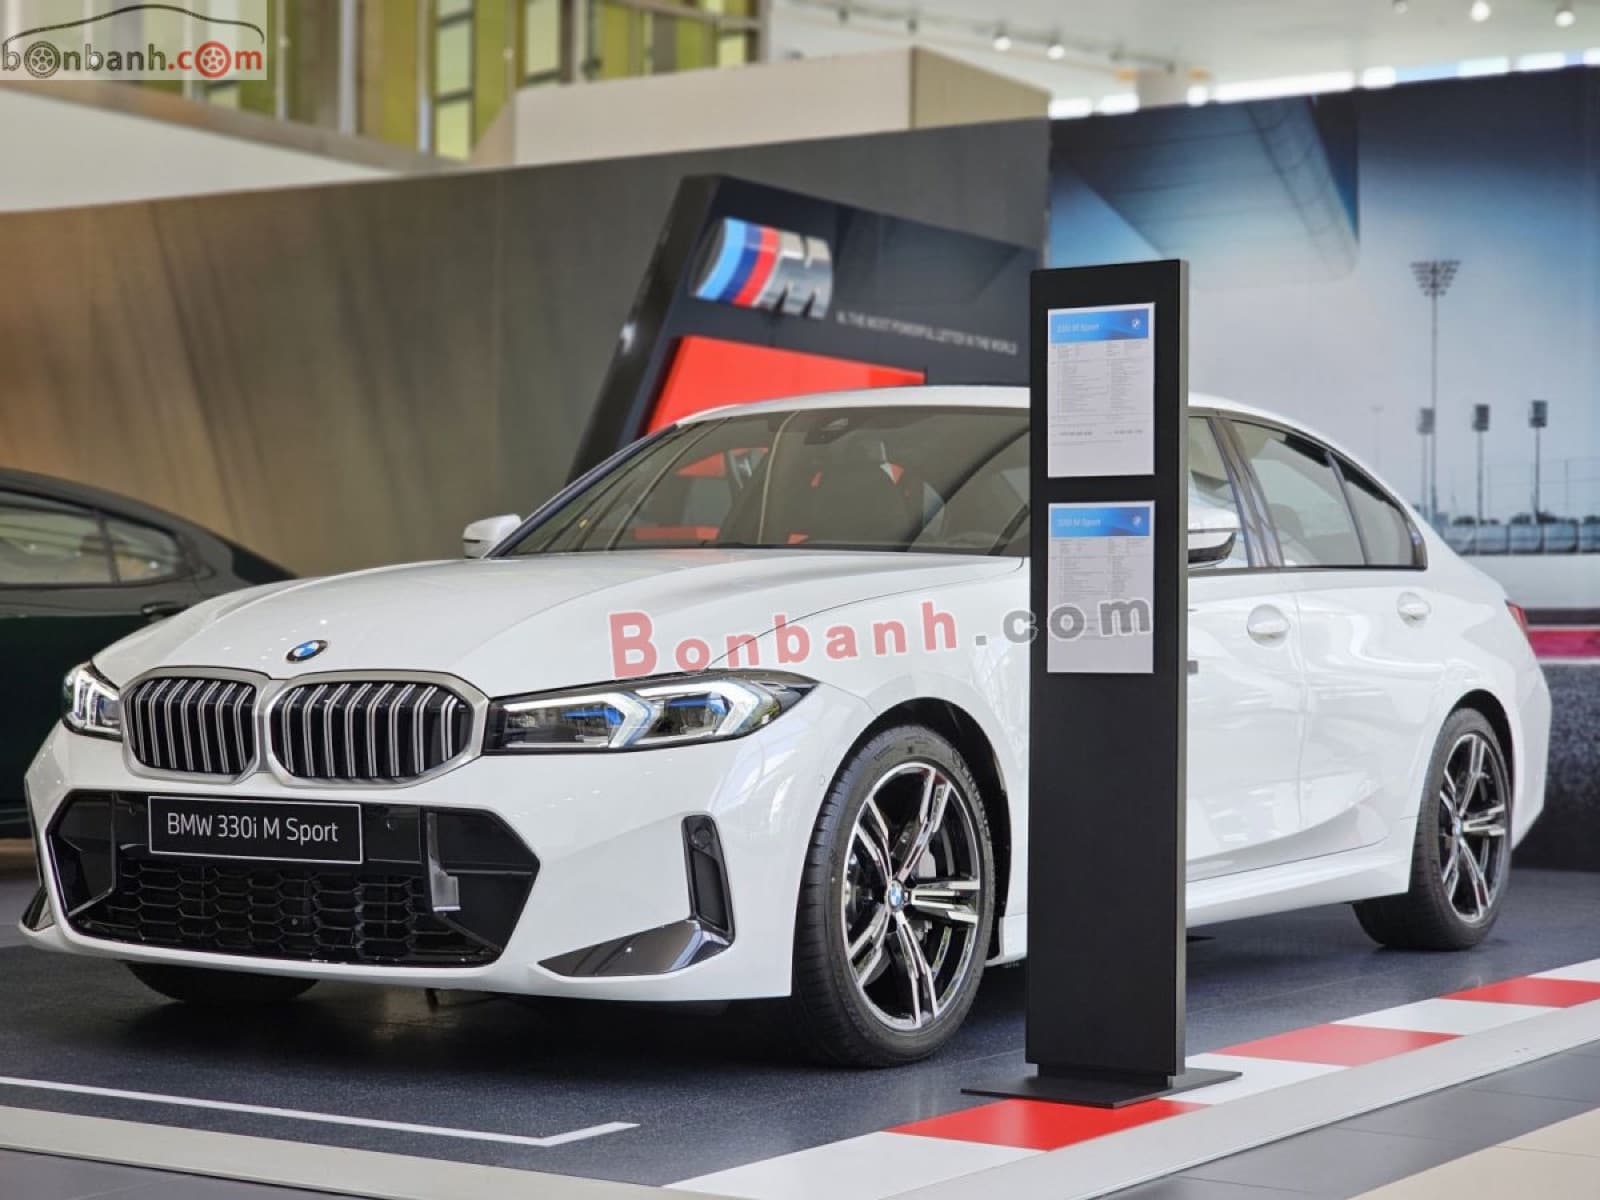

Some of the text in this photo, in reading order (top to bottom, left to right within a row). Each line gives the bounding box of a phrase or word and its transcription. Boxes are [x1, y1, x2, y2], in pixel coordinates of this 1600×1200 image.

[167, 812, 340, 846] BMW 330i M Sport
